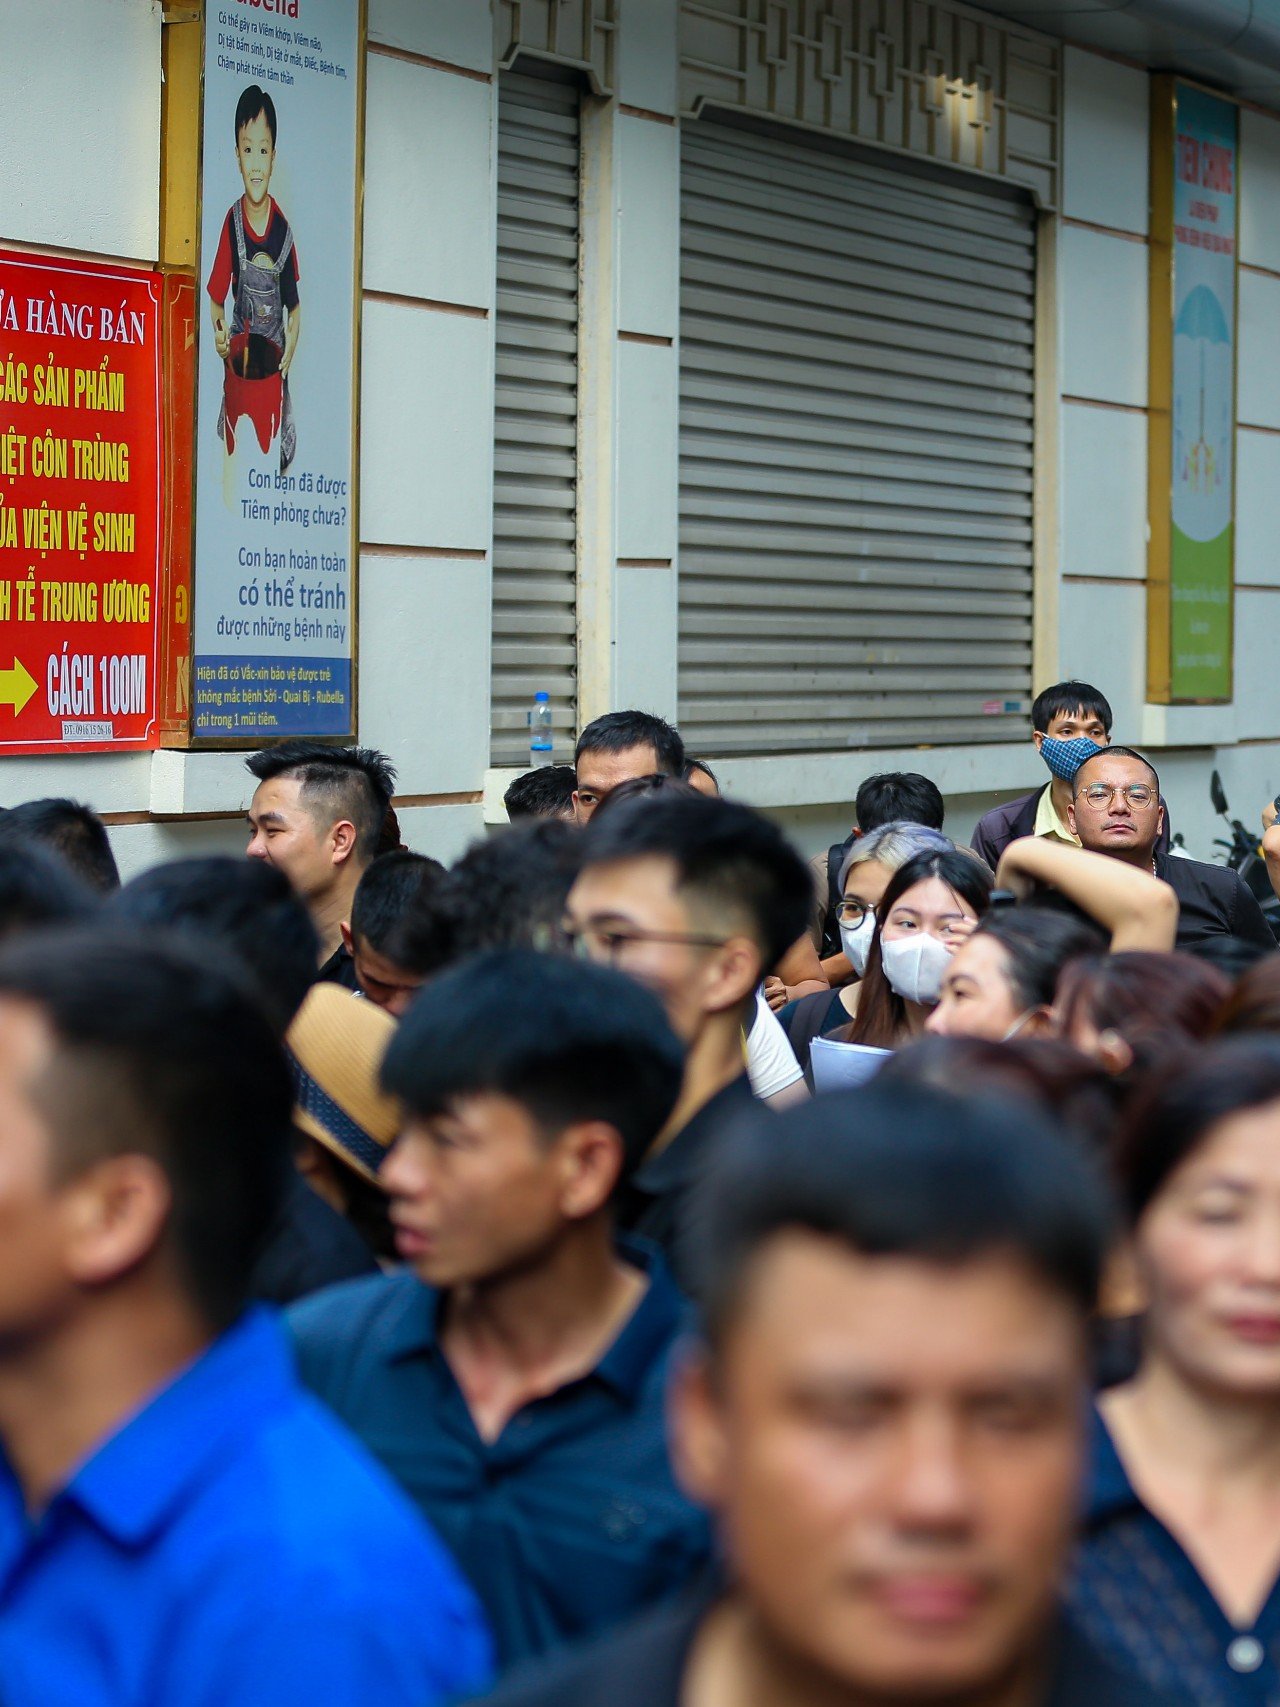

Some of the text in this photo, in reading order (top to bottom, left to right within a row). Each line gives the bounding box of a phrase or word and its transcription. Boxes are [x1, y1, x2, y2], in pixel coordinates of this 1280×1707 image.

[219, 11, 227, 25] Có
[251, 23, 257, 33] ra
[259, 22, 274, 38] Viêm
[218, 33, 225, 48] Dị
[251, 42, 265, 58] sinh,
[217, 55, 235, 71] Chậm
[237, 60, 250, 74] phát
[26, 290, 94, 340] HÀNG
[99, 299, 146, 346] BÁN
[33, 352, 69, 408] SẢN
[74, 355, 125, 412] PHẨM
[31, 428, 68, 479] CÔN
[72, 432, 129, 483] TRÙNG
[248, 468, 347, 499] Con bạn đã được
[241, 499, 347, 528] Tiêm phòng chưa?
[22, 500, 62, 559] VIỆN
[66, 502, 88, 561] VỆ
[93, 511, 135, 553] SINH
[238, 547, 346, 573] Con bạn hoàn toàn
[16, 565, 36, 622] TỄ
[41, 581, 98, 623] TRUNG
[102, 578, 150, 623] ƯƠNG
[238, 576, 346, 610] có thể tránh
[216, 614, 346, 644] được những bệnh này
[47, 641, 147, 717] CÁCH 100M
[197, 667, 216, 683] Hiện
[217, 666, 228, 681] đã
[229, 667, 240, 681] có
[270, 665, 285, 681] bảo
[297, 667, 318, 684] được
[197, 689, 222, 706] không
[224, 687, 240, 704] mắc
[242, 689, 262, 706] bệnh
[283, 689, 301, 705] Quai
[302, 690, 310, 706] Bị
[316, 690, 344, 705] Rubella
[197, 711, 278, 729] chỉ trong 1 mũi tiêm.
